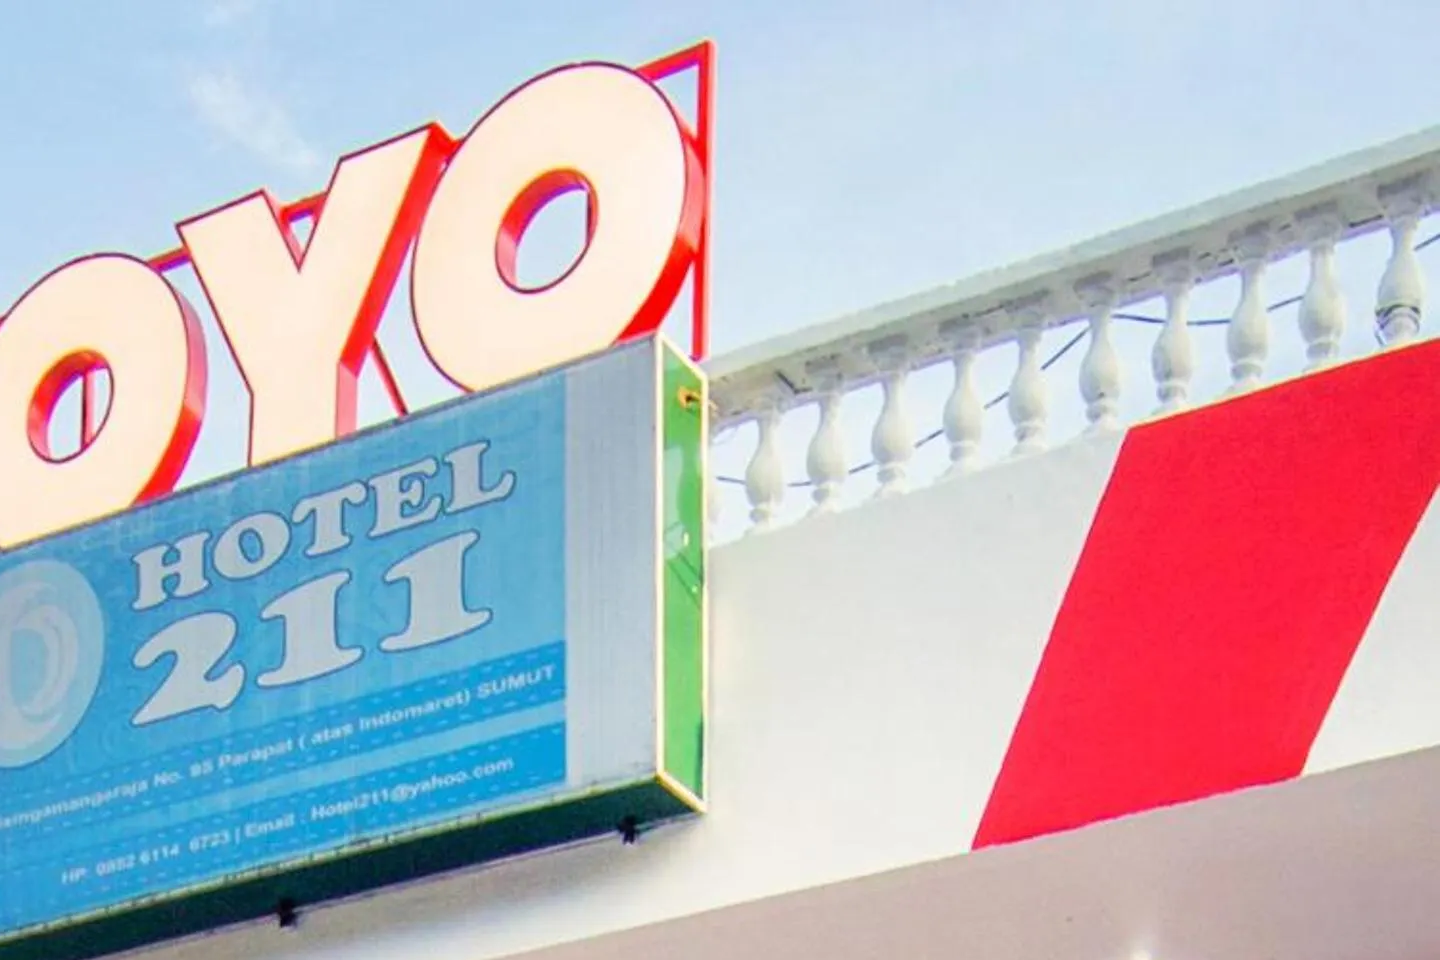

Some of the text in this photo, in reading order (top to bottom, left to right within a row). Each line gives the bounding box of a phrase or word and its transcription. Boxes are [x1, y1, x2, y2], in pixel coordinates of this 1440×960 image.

[131, 439, 516, 610] HOTEL
[130, 528, 492, 726] 211
[218, 738, 293, 768] Parapat
[311, 723, 354, 745] atas
[360, 689, 470, 732] Indomaret)
[477, 664, 556, 699] SUMUT
[244, 812, 295, 838] Email
[311, 757, 515, 821] Hotel211@yahoo.com
